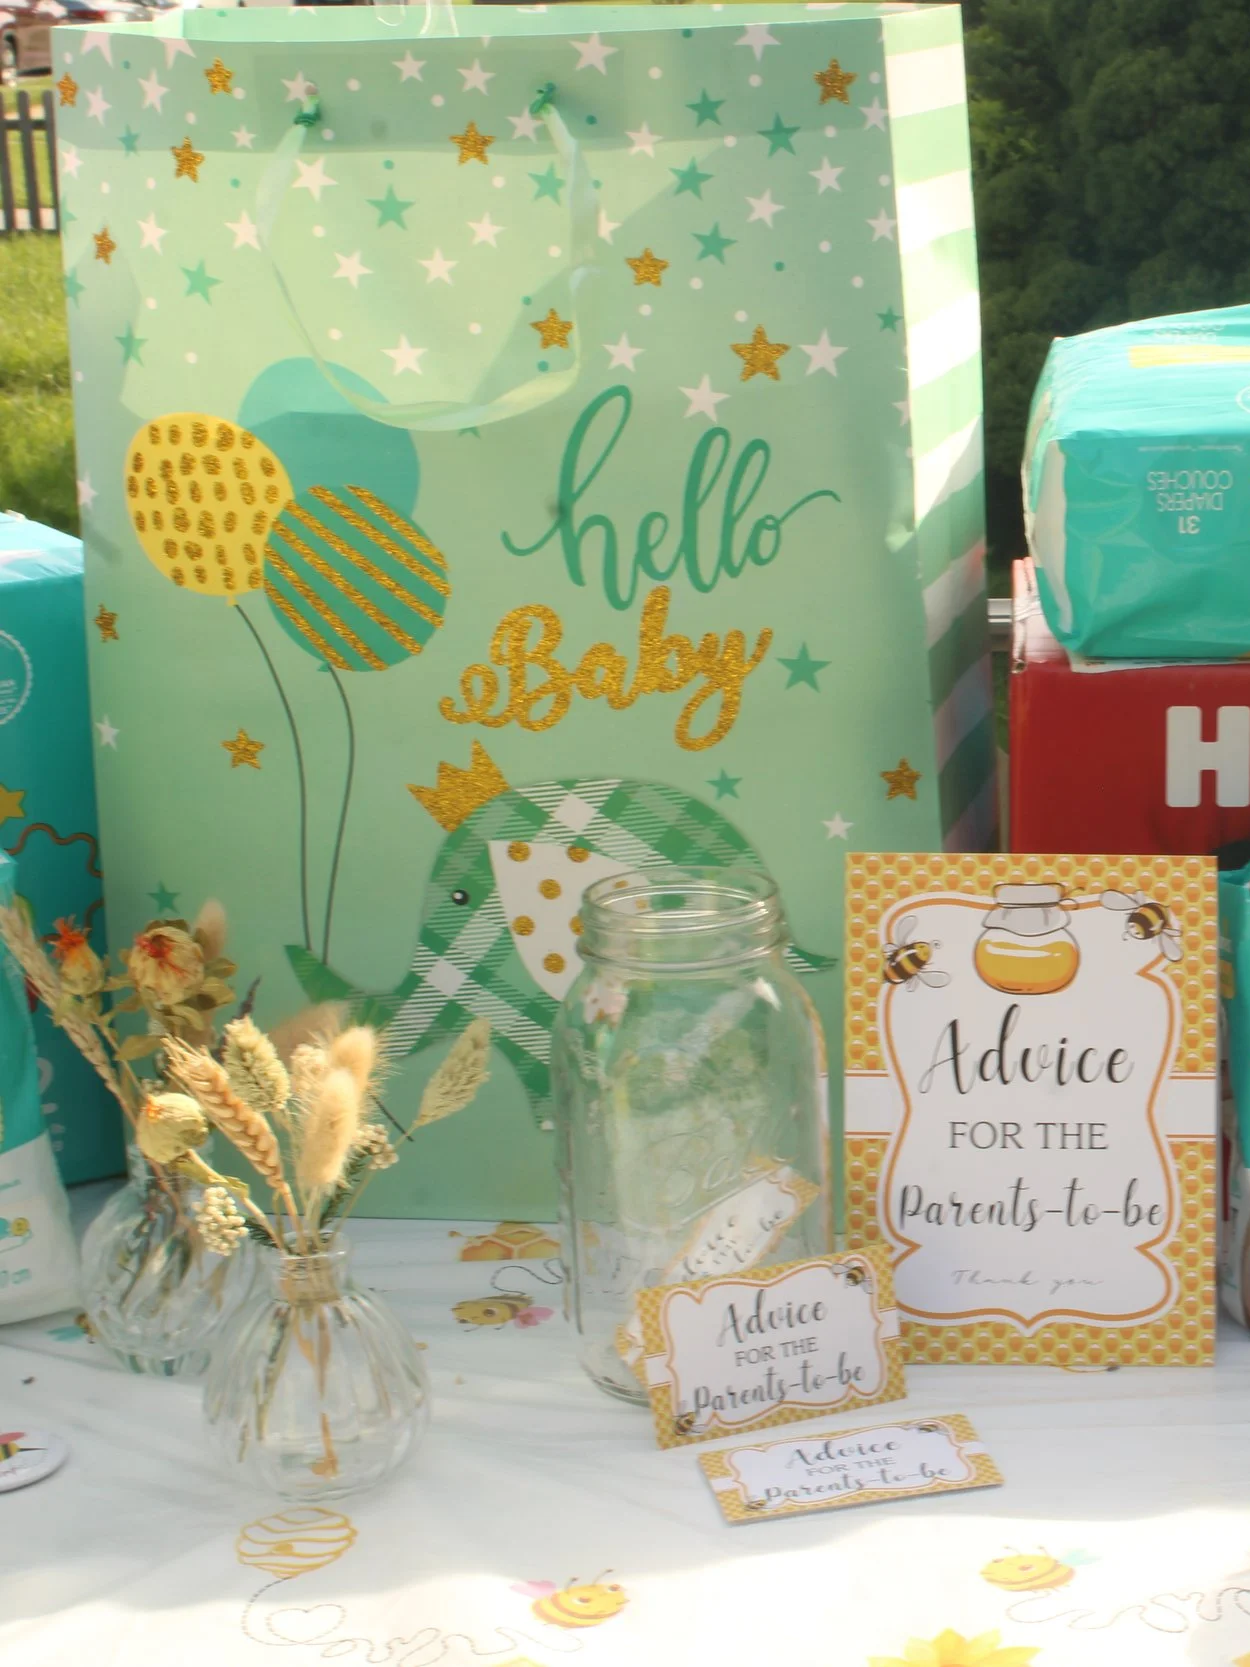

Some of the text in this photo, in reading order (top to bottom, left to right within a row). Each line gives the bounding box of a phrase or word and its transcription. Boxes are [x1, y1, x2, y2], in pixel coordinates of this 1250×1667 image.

[1146, 469, 1234, 491] COUCHES
[502, 384, 842, 612] hello
[1156, 491, 1225, 512] DIAPERS
[1177, 515, 1201, 534] 31
[439, 585, 773, 752] Baby
[917, 1003, 1135, 1095] Advice
[948, 1120, 1110, 1150] FOR THE
[899, 1176, 1163, 1233] Parents-to-be
[950, 1269, 1105, 1296] Thank you
[715, 1288, 829, 1348] Advice
[734, 1336, 819, 1367] FOR THE
[691, 1352, 866, 1418] Parents-to-be
[785, 1440, 900, 1469] Advice
[805, 1456, 897, 1478] FOR THE
[763, 1462, 951, 1502] Parents-to-be
